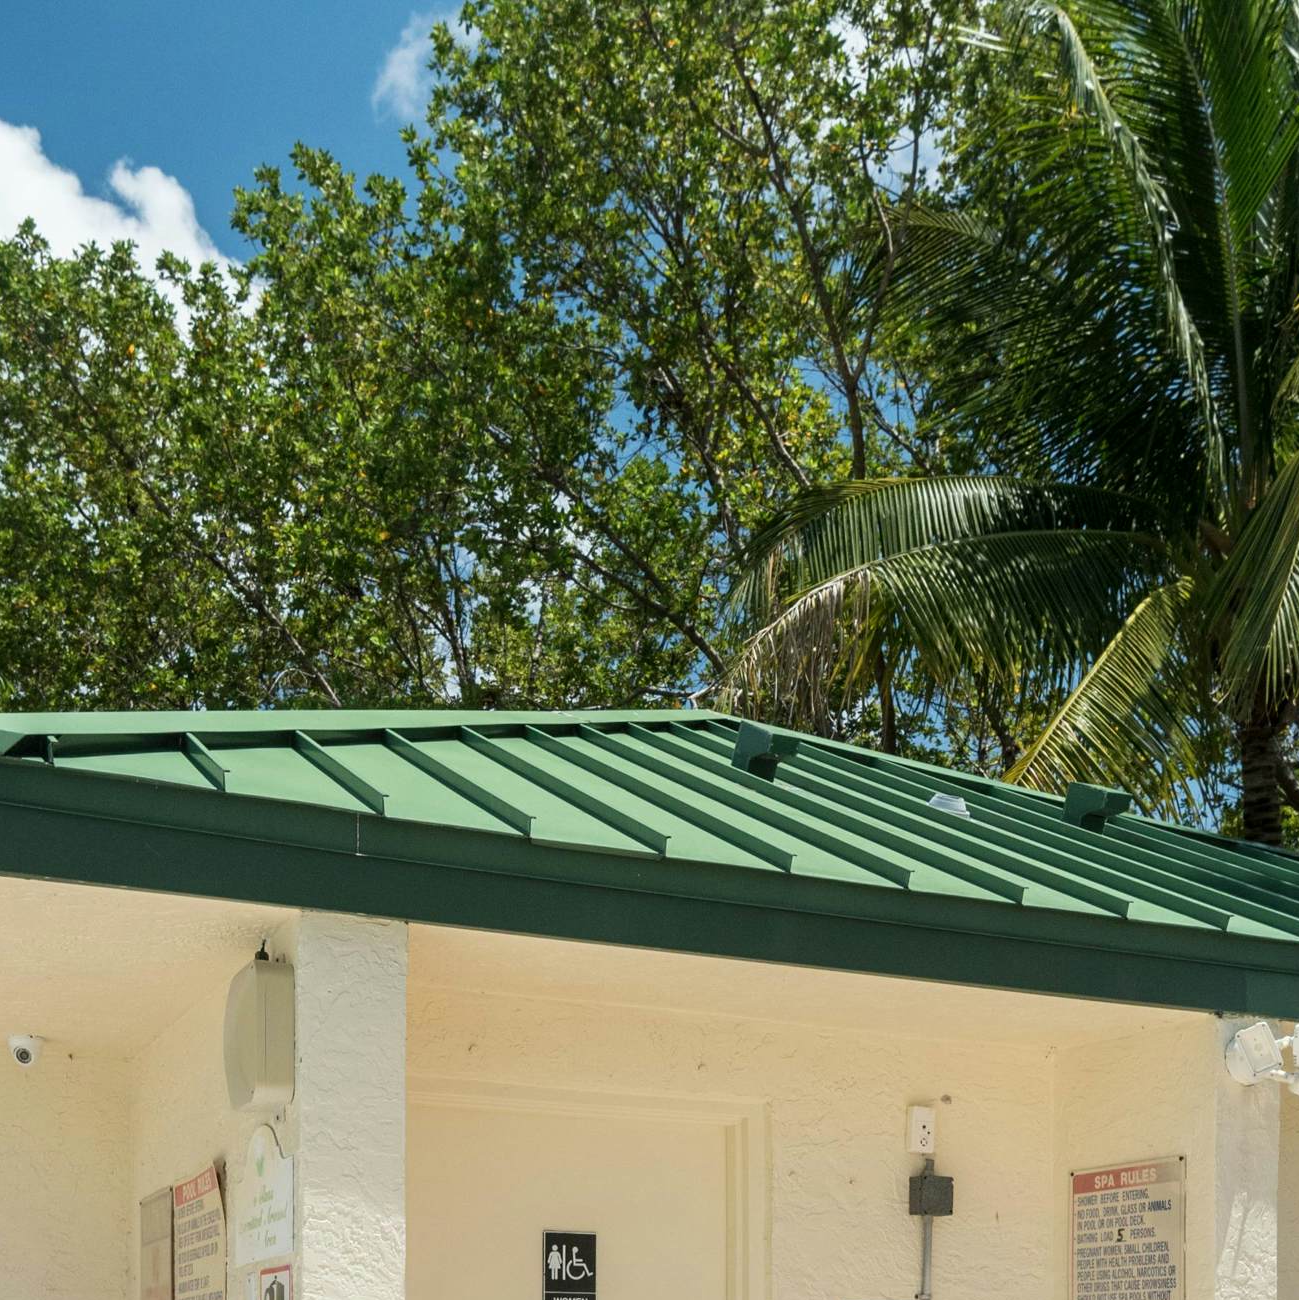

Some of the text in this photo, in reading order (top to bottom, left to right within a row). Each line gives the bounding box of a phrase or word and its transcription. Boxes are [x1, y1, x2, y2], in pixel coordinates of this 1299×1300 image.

[1094, 1168, 1157, 1189] SPA RULES
[1100, 1192, 1119, 1203] BEFORE
[1077, 1209, 1085, 1219] NO
[1121, 1203, 1137, 1215] GLASS
[1138, 1202, 1146, 1212] OR
[1147, 1200, 1172, 1211] ANIMALS
[1084, 1220, 1096, 1230] POOL
[1115, 1216, 1129, 1227] POOL
[1101, 1231, 1114, 1242] LOAD
[1117, 1228, 1125, 1242] 5
[1124, 1243, 1140, 1254] SMALL
[1077, 1253, 1169, 1270] PEOPLE WITH HEALTH PROBLEMS AND
[1077, 1270, 1094, 1281] PEOPLE
[1136, 1266, 1167, 1278] NARCOTICS
[1168, 1265, 1176, 1276] OR
[1094, 1281, 1110, 1292] DRUGS
[1111, 1280, 1123, 1291] THAT
[1124, 1279, 1140, 1290] CAUSE
[1142, 1278, 1177, 1290] DROWSINESS
[1147, 1290, 1171, 1300] WITHOUT
